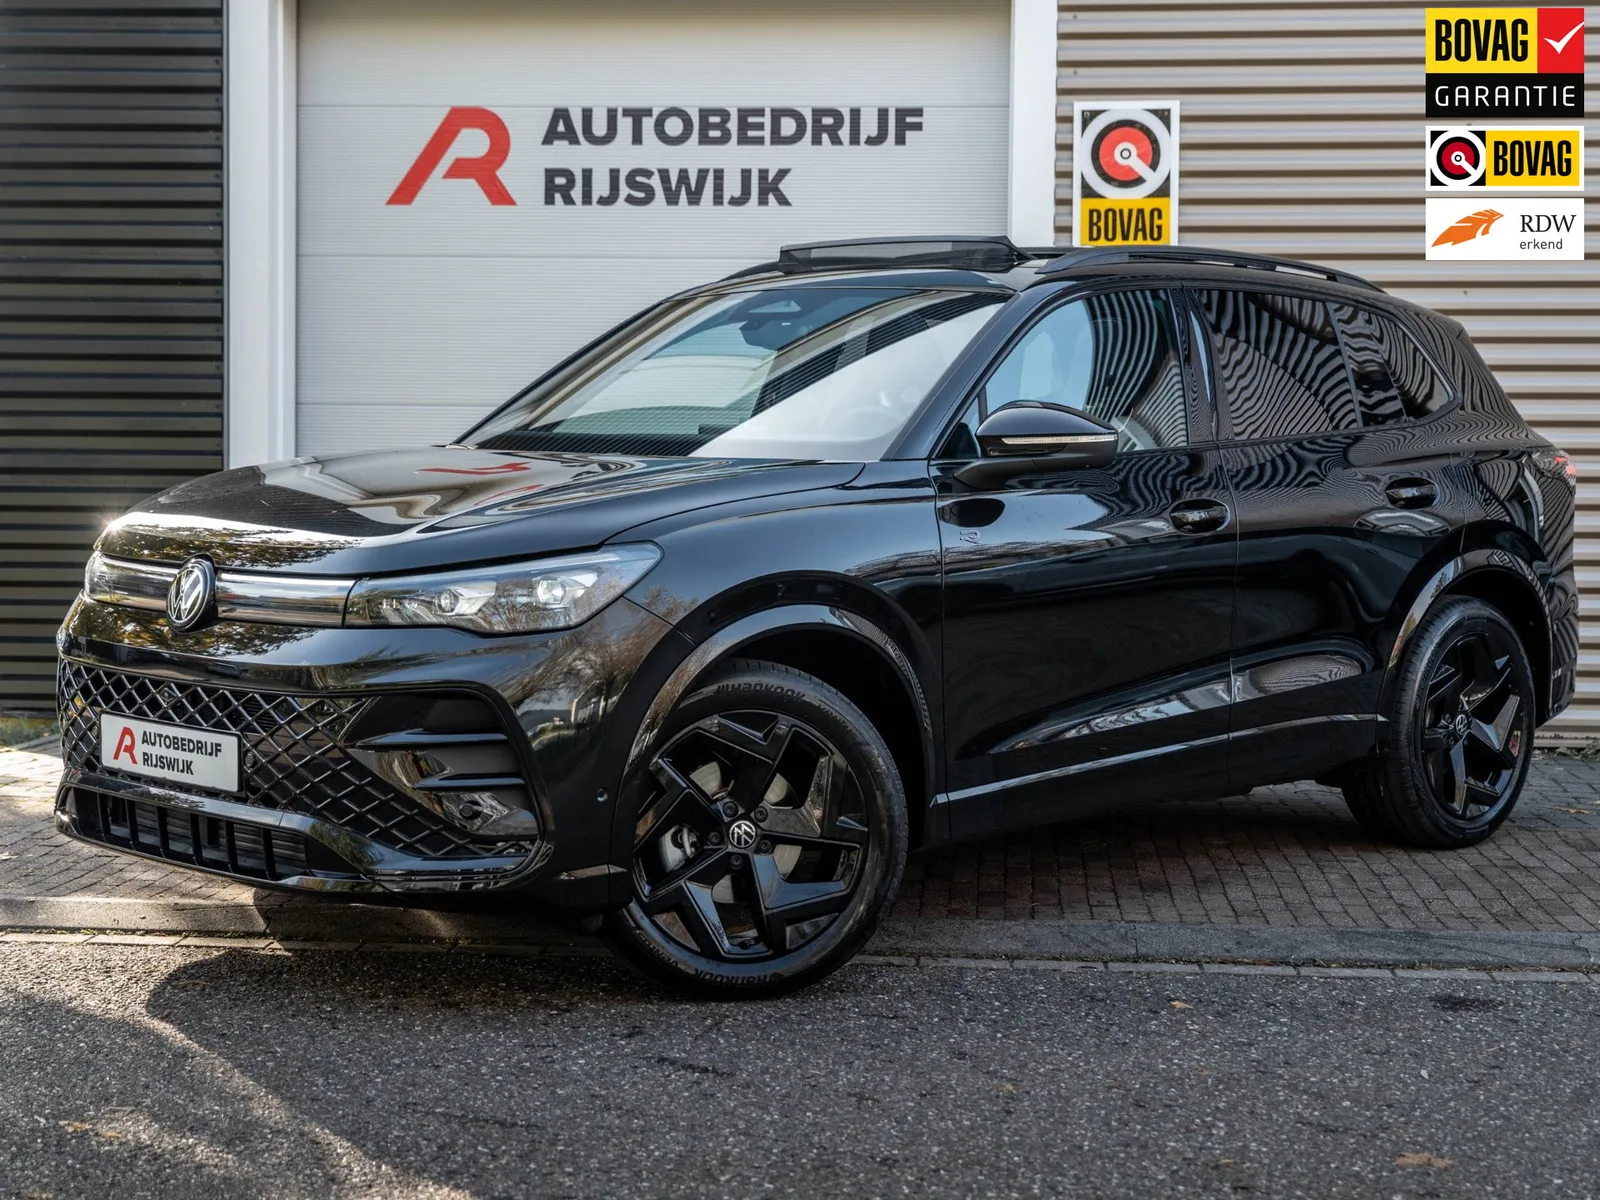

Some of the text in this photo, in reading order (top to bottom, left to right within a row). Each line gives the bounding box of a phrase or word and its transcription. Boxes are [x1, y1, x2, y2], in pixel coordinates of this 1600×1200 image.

[541, 107, 924, 146] AUTOBEDRIJF
[543, 168, 793, 207] RIJSWIJK
[1088, 207, 1163, 242] BOVAG
[142, 730, 222, 757] AUTOBEDRIJF
[142, 752, 194, 775] RIJSWIJK
